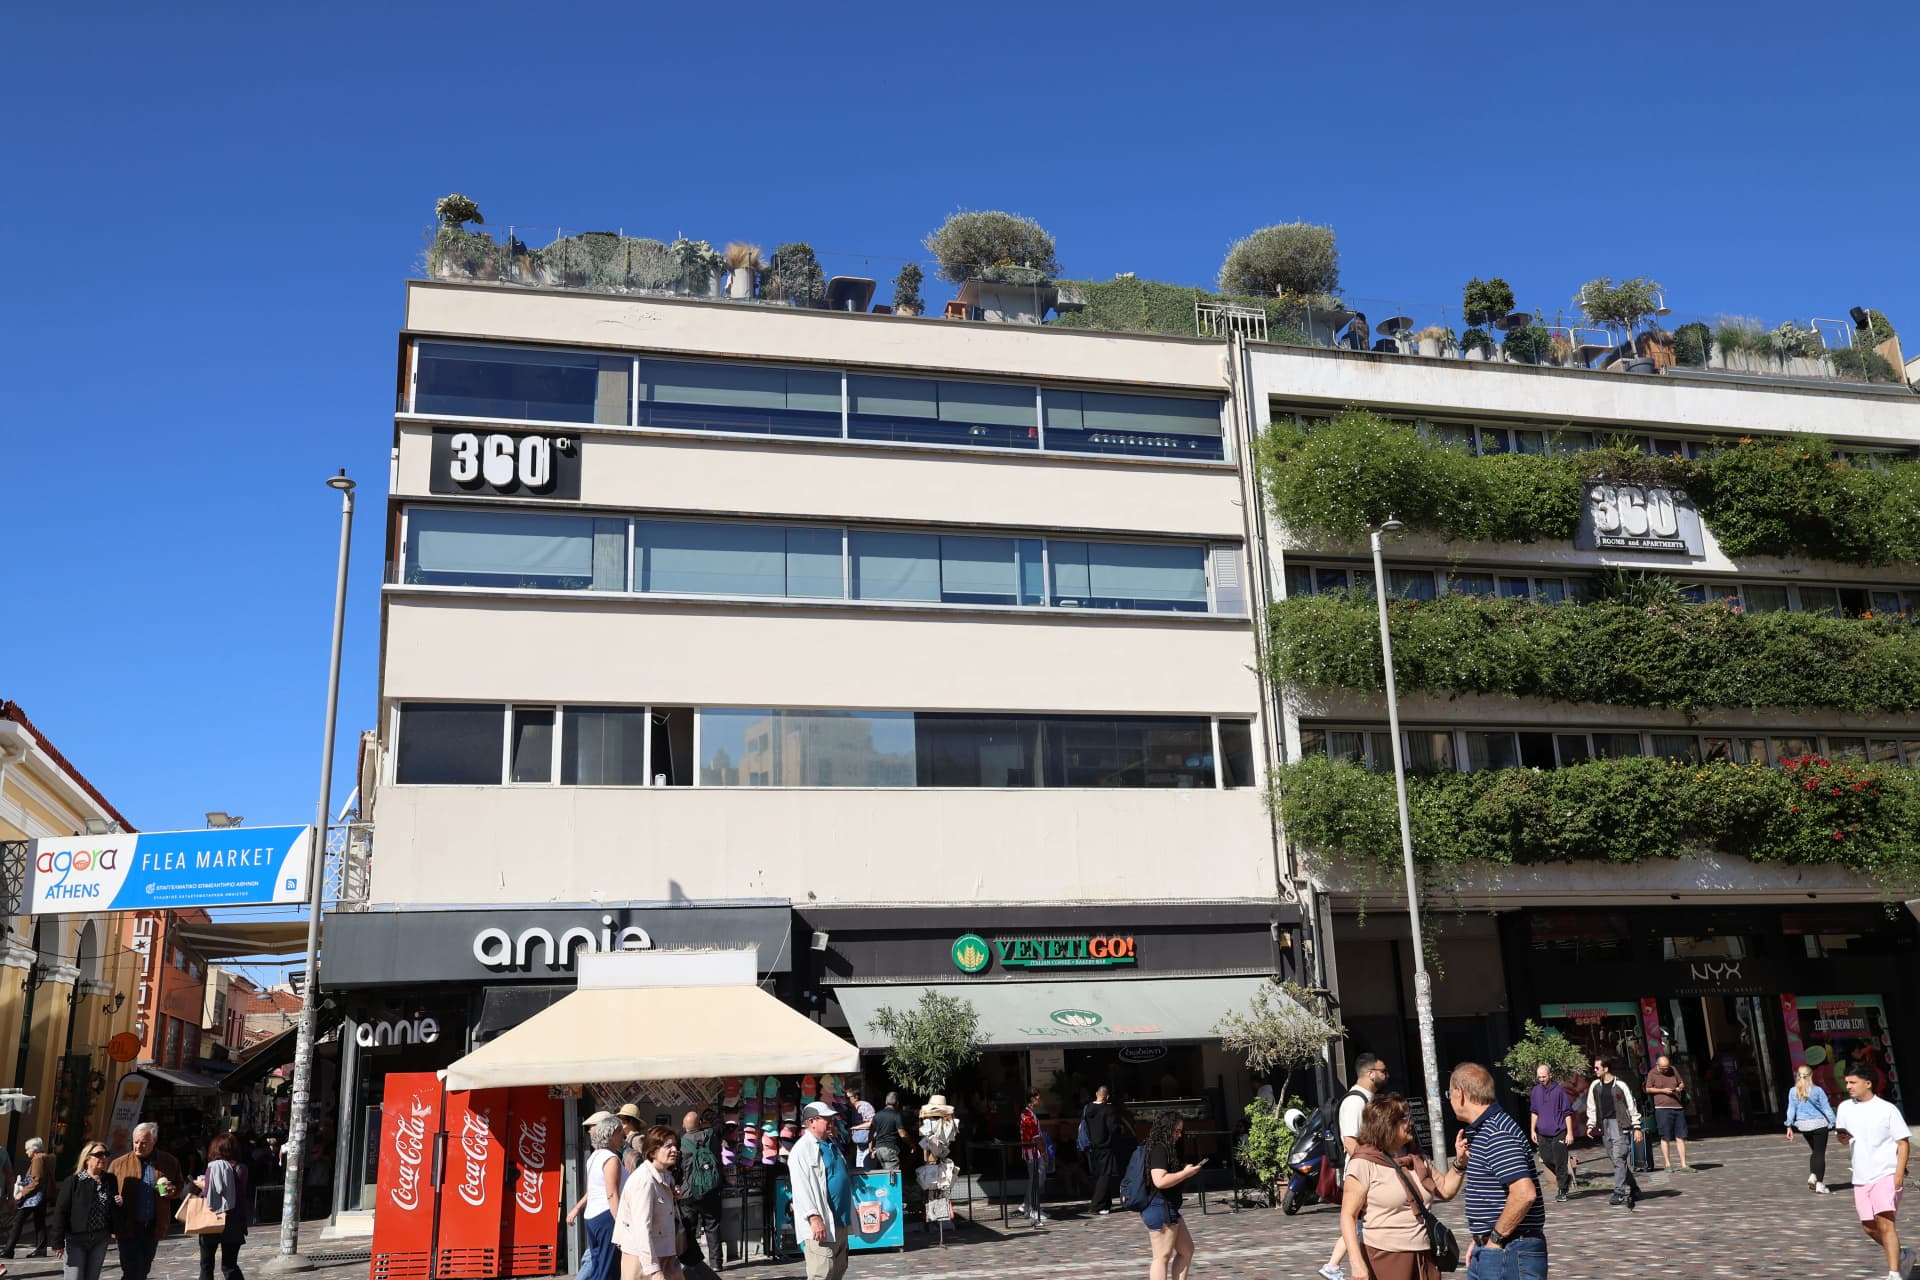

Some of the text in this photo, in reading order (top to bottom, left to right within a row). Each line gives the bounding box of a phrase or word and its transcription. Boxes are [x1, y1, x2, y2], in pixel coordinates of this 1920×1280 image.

[1642, 539, 1684, 548] APARTMENTS
[36, 849, 118, 887] agora
[142, 847, 275, 872] FLEA MARKET
[45, 883, 101, 900] ATHENS
[473, 914, 651, 967] annie
[1691, 962, 1742, 980] NYX
[356, 1011, 440, 1048] annie
